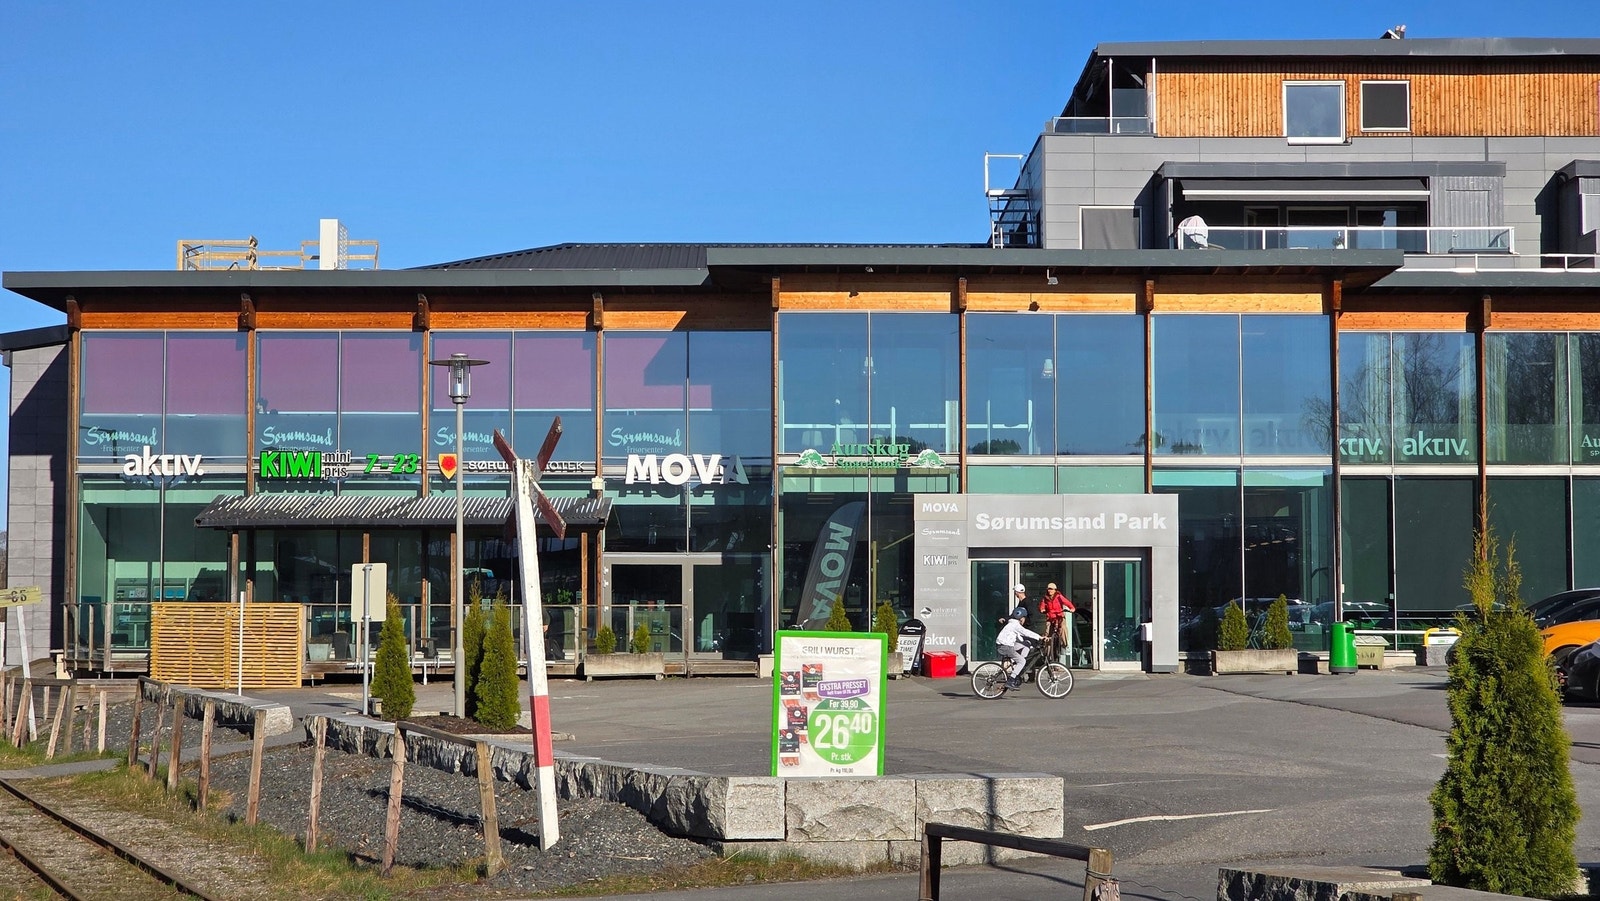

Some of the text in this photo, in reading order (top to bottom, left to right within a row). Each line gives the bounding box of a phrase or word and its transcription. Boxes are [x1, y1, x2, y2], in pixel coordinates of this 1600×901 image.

[829, 438, 911, 461] Aurskog
[1402, 430, 1470, 456] aktiv.
[123, 445, 205, 476] aktiv.
[260, 451, 322, 479] KIWI
[323, 449, 351, 464] mini
[323, 464, 348, 480] pris
[625, 453, 750, 486] MOVA
[922, 502, 959, 513] MOVA
[975, 512, 1167, 531] Sørumsand Park
[923, 555, 947, 566] KIWI
[809, 521, 853, 620] MOVA
[925, 633, 956, 646] aktiv.
[820, 680, 867, 691] EKSTRA PRESSET
[814, 712, 872, 750] 26 40
[831, 752, 854, 761] Pr. stk.
